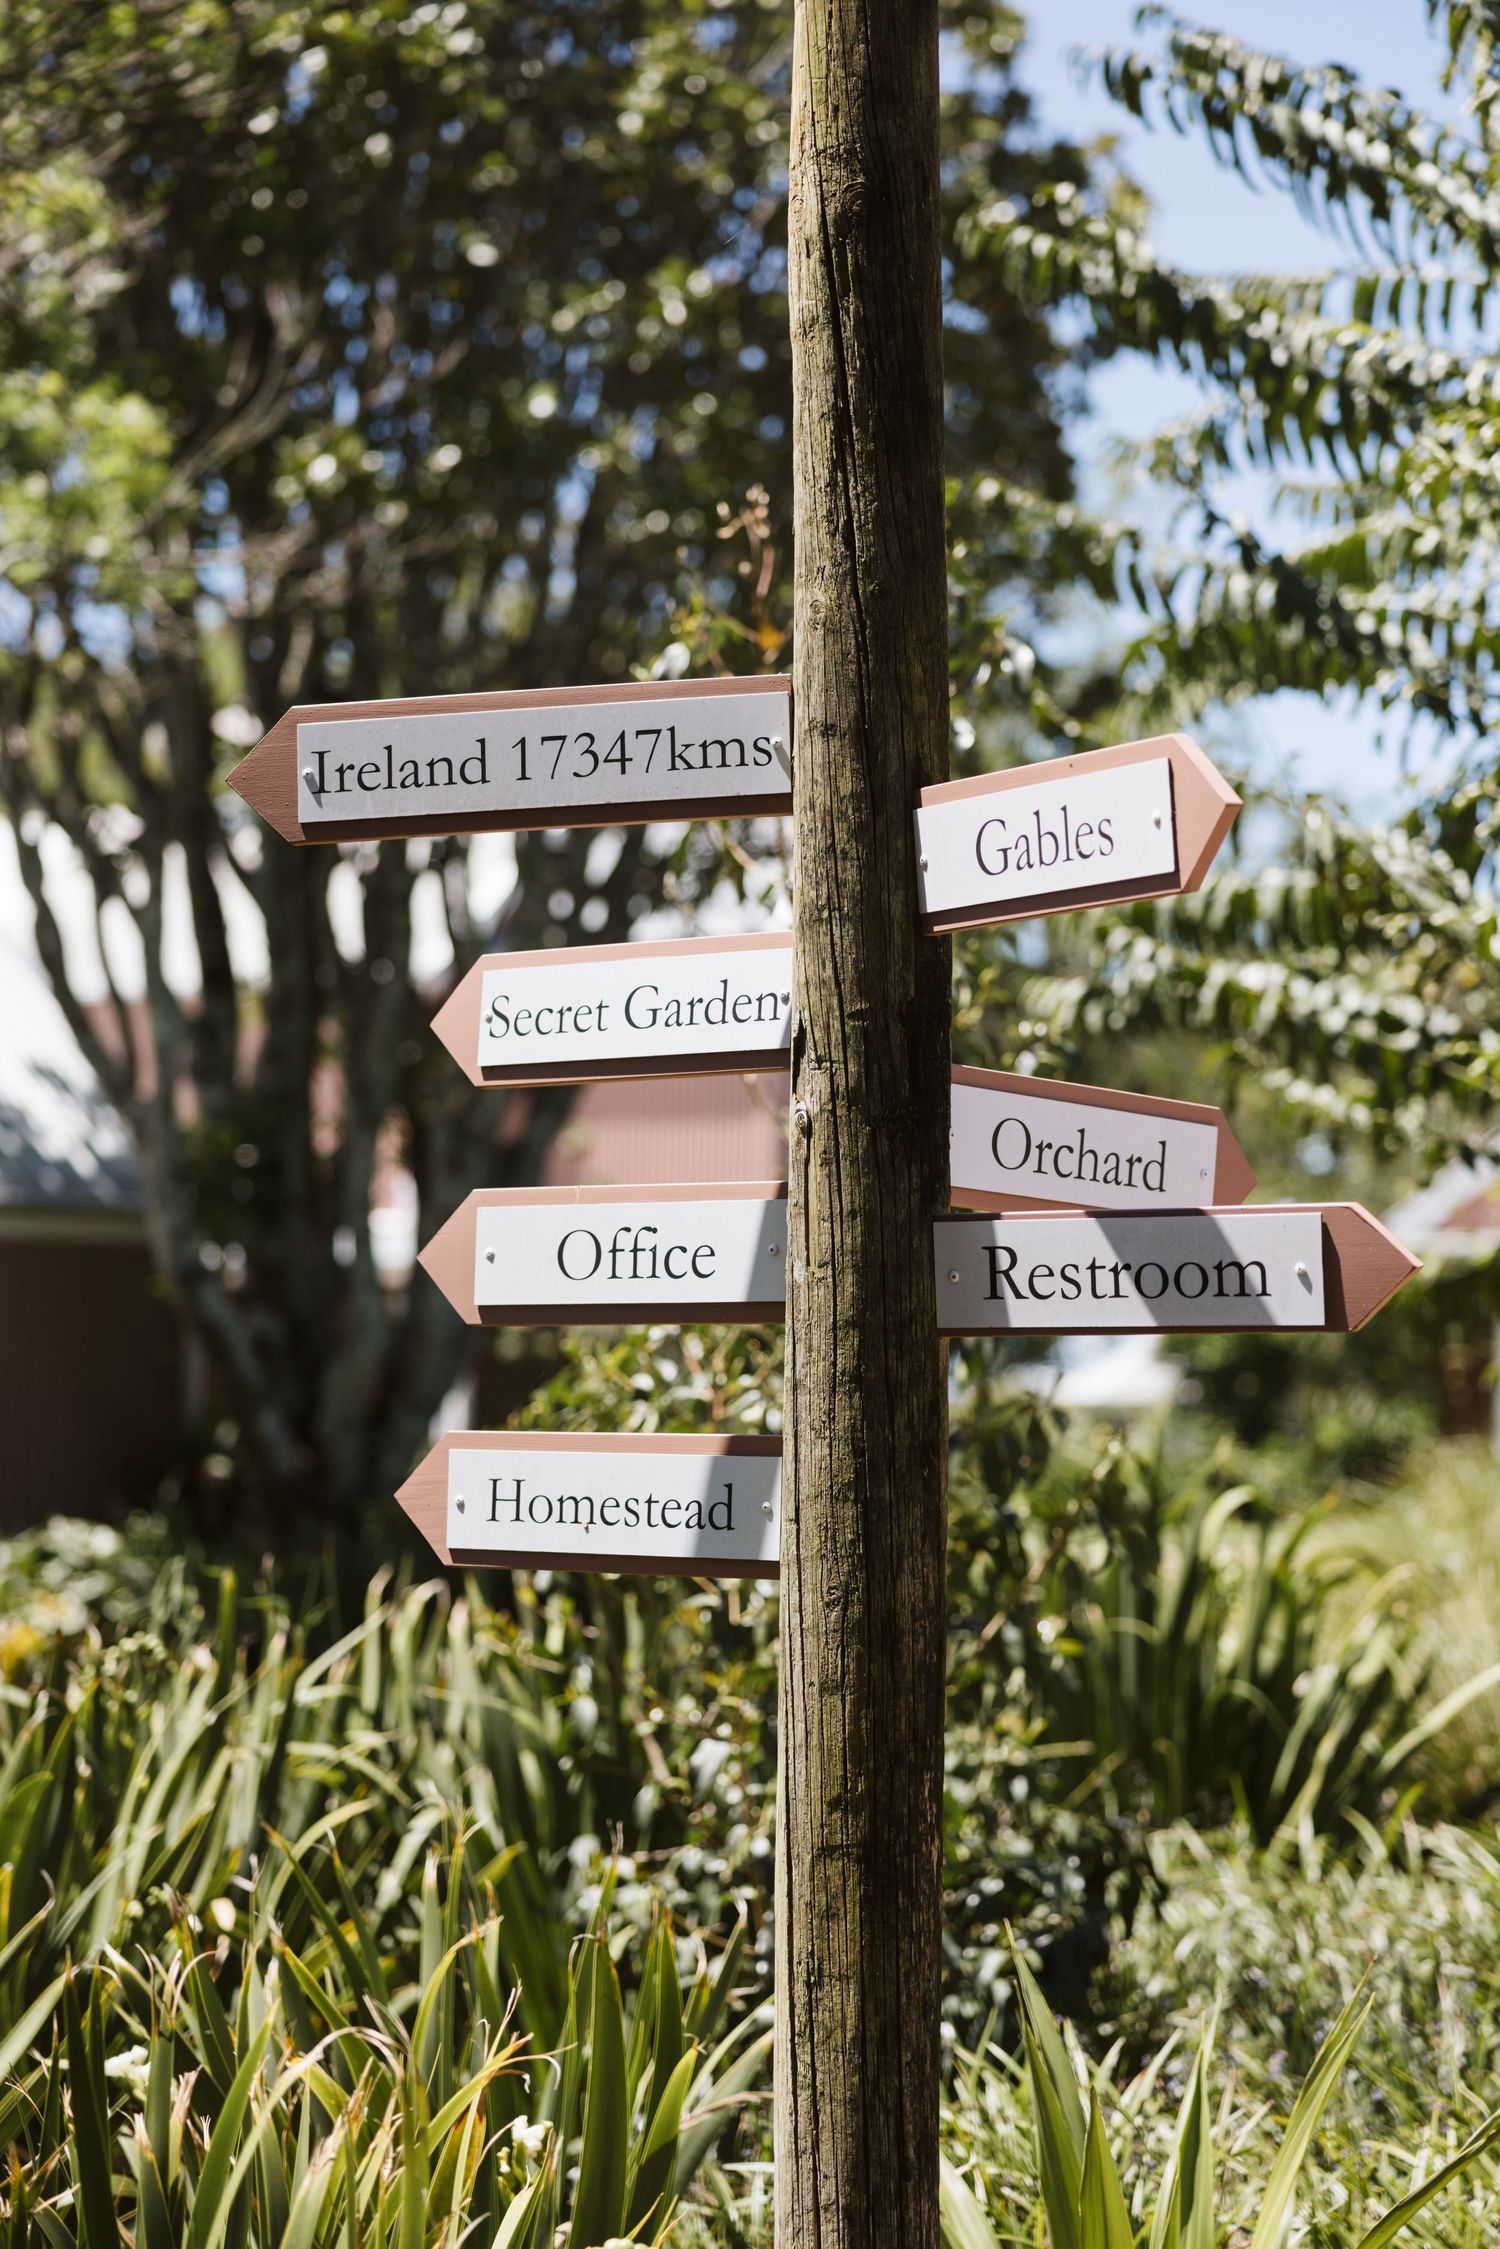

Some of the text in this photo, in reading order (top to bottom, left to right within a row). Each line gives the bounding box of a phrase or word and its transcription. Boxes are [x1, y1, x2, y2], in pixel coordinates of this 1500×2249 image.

[310, 738, 491, 796] Ireland
[975, 805, 1115, 876] Gables
[487, 979, 781, 1039] Secret Garden
[991, 1117, 1167, 1193] Orchard
[557, 1225, 717, 1281] Office
[982, 1245, 1272, 1301] Restroom
[486, 1478, 735, 1531] Homestead
